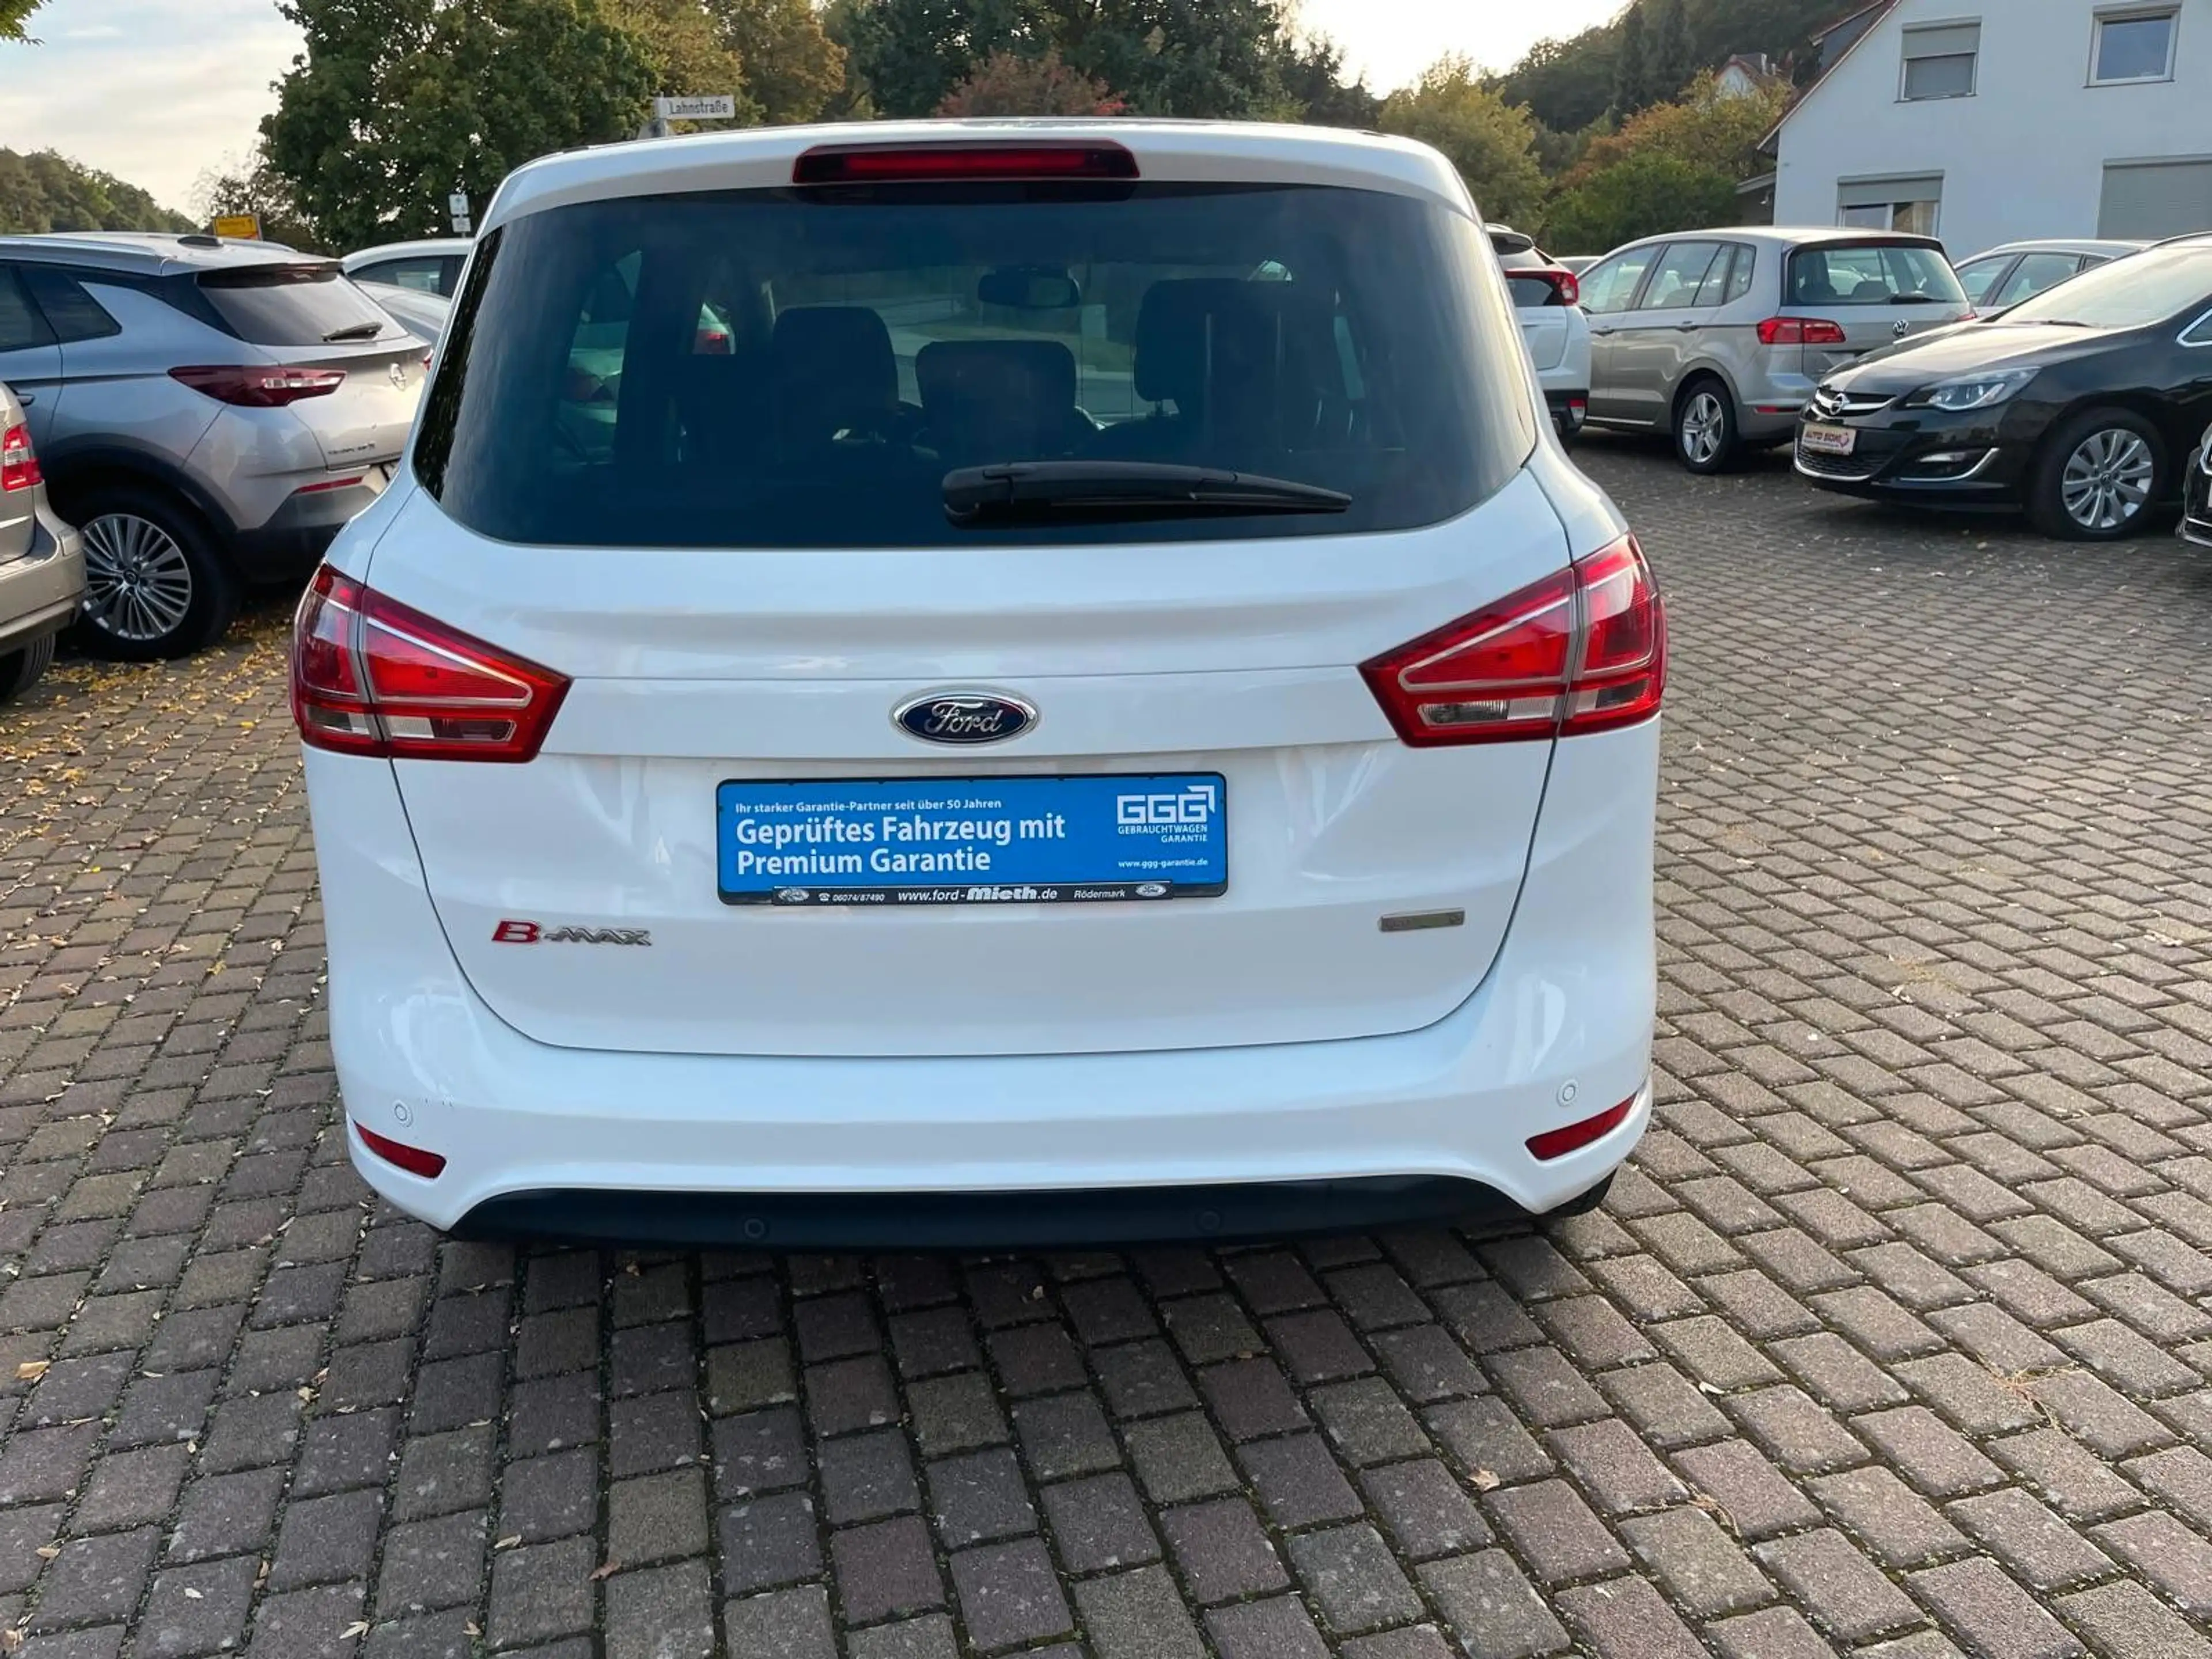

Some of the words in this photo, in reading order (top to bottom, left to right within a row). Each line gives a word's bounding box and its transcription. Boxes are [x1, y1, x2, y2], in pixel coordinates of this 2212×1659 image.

[669, 99, 728, 114] Lahnstraße
[924, 701, 1003, 733] Ford
[736, 802, 751, 813] Ihr
[754, 802, 793, 813] starker
[796, 801, 891, 812] Garantie-Partner
[895, 800, 915, 810] seit
[918, 800, 944, 810] über
[947, 799, 961, 809] 50
[963, 798, 1002, 809] Jahren
[1117, 793, 1207, 824] GGG
[736, 816, 874, 850] Geprüftes
[882, 814, 1011, 846] Fahrzeug
[1020, 812, 1066, 839] mit
[1118, 824, 1208, 835] GEBRAUCHTWAGEN
[1161, 834, 1208, 843] GARANTIE
[737, 849, 862, 875] Premium
[870, 846, 991, 872] Garantie
[1118, 858, 1209, 869] www.ggg-garantie.de
[1074, 889, 1126, 899] Rödermark
